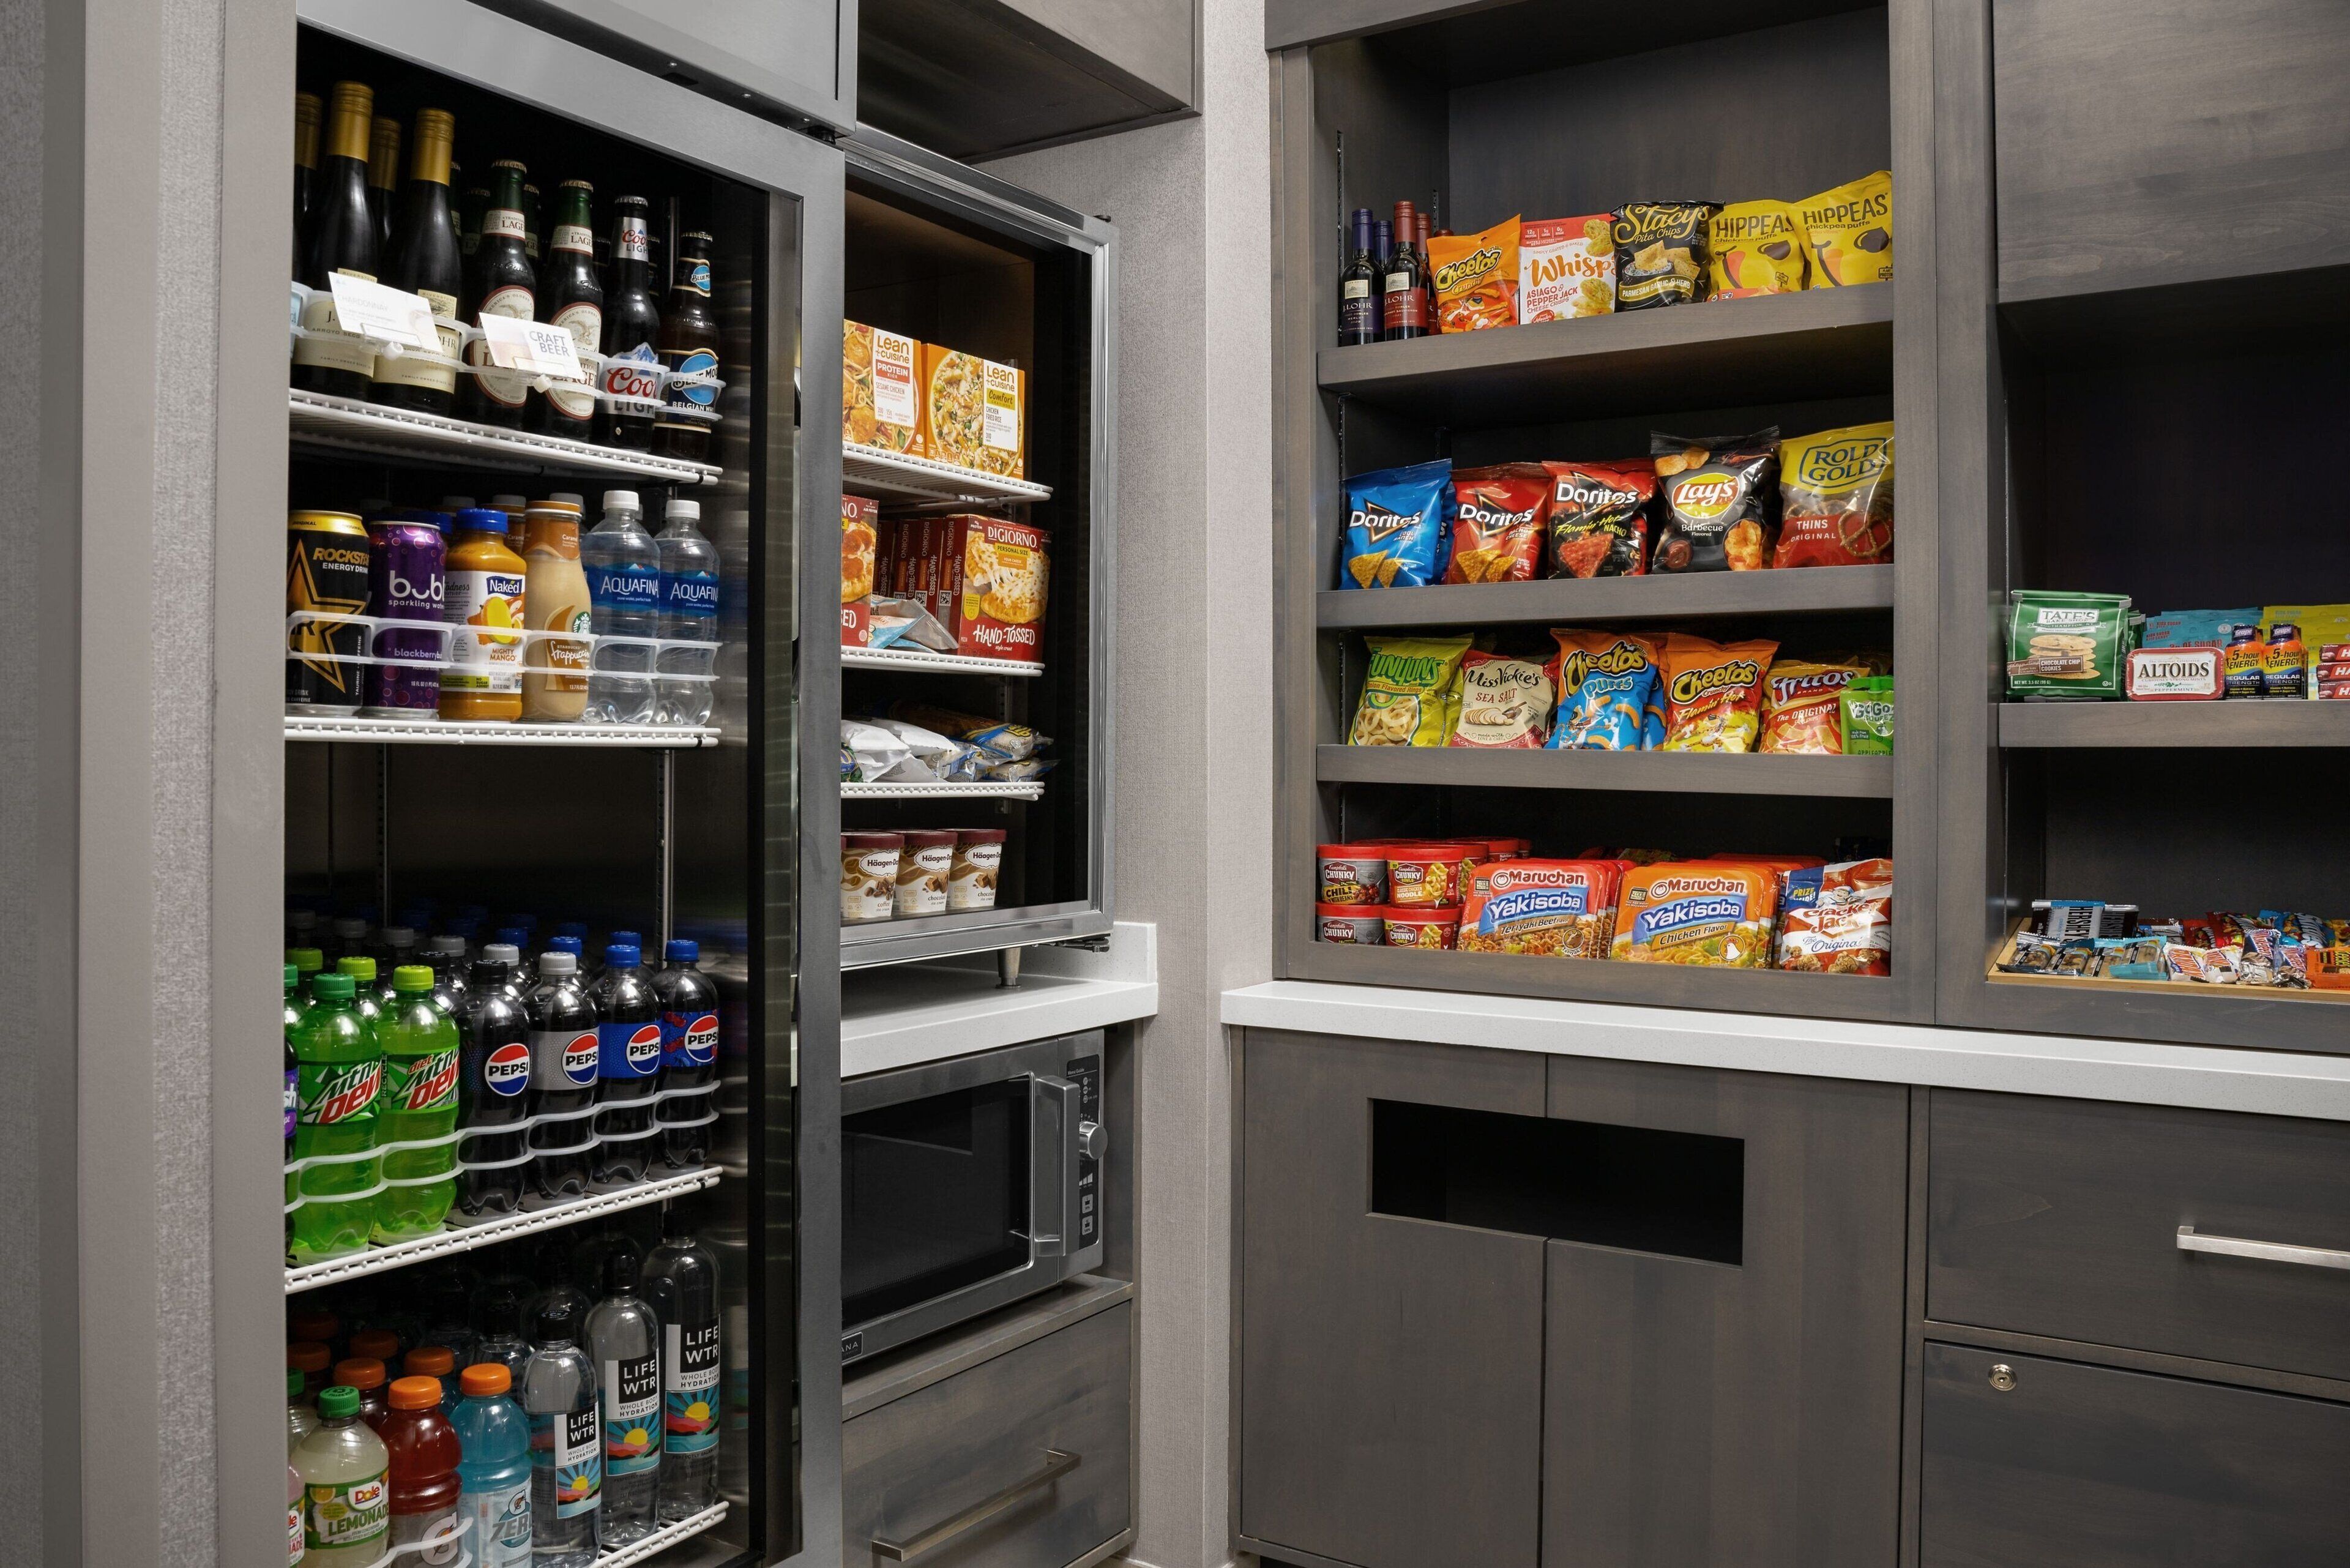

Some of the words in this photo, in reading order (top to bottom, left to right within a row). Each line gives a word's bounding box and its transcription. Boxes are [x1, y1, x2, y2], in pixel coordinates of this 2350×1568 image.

[1802, 193, 1889, 225] HIPPEAS
[502, 220, 524, 230] LAGE
[1614, 204, 1710, 244] Stacy's
[1847, 220, 1871, 230] puffs
[570, 234, 592, 246] LAGE
[1633, 234, 1655, 244] Pita
[1656, 227, 1682, 239] Chips
[1754, 233, 1777, 242] puffs
[626, 244, 647, 253] LIGH
[1435, 250, 1501, 290] Cheetos
[1452, 277, 1484, 295] Crunchy
[1526, 286, 1557, 300] ASIAGO
[1622, 286, 1651, 297] PARMESAN
[1650, 280, 1668, 291] GARLIC
[1676, 279, 1691, 289] HERB
[1526, 295, 1559, 308] PEPPER
[1559, 286, 1578, 301] JACK
[1526, 304, 1549, 314] CHEESE
[1549, 297, 1569, 308] CRISPS
[529, 330, 565, 347] CRAFT
[877, 335, 909, 355] Lean
[539, 343, 570, 357] BEER
[877, 362, 908, 377] PROTEIN
[987, 365, 1015, 384] Lean
[876, 382, 890, 391] SESAME
[890, 385, 905, 395] CHICKEN
[988, 390, 1013, 405] Comfort
[614, 400, 654, 415] LIGH
[673, 401, 705, 412] BELGIAN
[986, 406, 999, 416] CHICKEN
[986, 413, 995, 422] FRIED
[1813, 443, 1879, 466] ROLD
[1808, 460, 1876, 482] GOLD
[1555, 483, 1641, 504] Doritos
[1676, 480, 1736, 507] Lay's
[1349, 510, 1422, 528] Doritos
[1459, 503, 1535, 527] Doritos
[1599, 513, 1622, 526] Hot
[1603, 524, 1627, 537] NACHO
[1681, 522, 1723, 532] Barbecue
[1796, 519, 1829, 531] THINS
[921, 521, 930, 556] DIGIORNO
[987, 526, 1037, 548] DIGIORNO
[1791, 532, 1837, 542] ORIGINAL
[313, 547, 369, 566] ROCKSTA
[997, 545, 1019, 554] PERSONAL
[322, 562, 354, 572] ENERGY
[928, 554, 938, 596] HAND-TOSSED
[953, 554, 962, 595] HAND-TOSSED
[490, 579, 520, 594] Naked
[600, 575, 659, 598] AQUAFINA
[388, 599, 430, 610] sparkling
[2042, 611, 2095, 620] TATE'S
[972, 624, 1035, 647] HAND-TOSSED
[2195, 639, 2222, 648] SUGAR
[550, 640, 591, 665] frappuccin
[2232, 650, 2259, 661] 5-hour
[2272, 648, 2300, 660] 5-hour
[1564, 643, 1647, 696] Cheetos
[2137, 662, 2210, 679] ALTOIDS
[2229, 659, 2259, 669] ENERGY
[2269, 658, 2299, 668] ENERGY
[1467, 669, 1499, 687] Miss
[1496, 663, 1542, 689] Vickie's
[1673, 661, 1758, 703] Cheetos
[1381, 684, 1406, 692] Flavored
[1475, 692, 1494, 704] SEA
[1498, 688, 1518, 703] SALT
[1770, 671, 1853, 705] Fritos
[1720, 692, 1745, 703] Hot
[1791, 703, 1836, 719] ORIGINAL
[1325, 870, 1355, 880] CHUNKY
[1395, 870, 1421, 881] CHUNKY
[1509, 870, 1586, 886] Maruchan
[1326, 886, 1352, 898] CHILI
[1668, 878, 1745, 894] Maruchan
[1792, 887, 1815, 897] PRIZE
[1490, 891, 1581, 919] Yakisoba
[1644, 900, 1740, 929] Yakisoba
[1324, 927, 1354, 938] CHUNKY
[1501, 919, 1538, 936] Teriyaki
[1537, 917, 1556, 928] Beef
[1390, 931, 1415, 941] CHUNKY
[1659, 927, 1701, 946] Chicken
[1703, 924, 1728, 935] Flavor
[1811, 937, 1862, 955] Original
[409, 1055, 433, 1073] diet
[565, 1051, 598, 1066] PEPSI
[488, 1061, 529, 1077] PEPSI
[686, 1325, 718, 1346] LIFE
[685, 1344, 718, 1364] WTR
[623, 1359, 656, 1379] LIFE
[681, 1371, 708, 1381] WHOLE
[623, 1376, 656, 1395] WTR
[680, 1374, 720, 1388] HYDRATION
[619, 1400, 644, 1411] WHOLE
[619, 1402, 658, 1417] HYDRATION
[570, 1410, 595, 1428] LIFE
[570, 1425, 595, 1442] WTR
[567, 1447, 583, 1457] WHOLE
[567, 1447, 597, 1462] HYDRATION
[354, 1485, 380, 1502] Dole
[328, 1502, 389, 1537] LEMONADE
[490, 1512, 532, 1543] ZER
